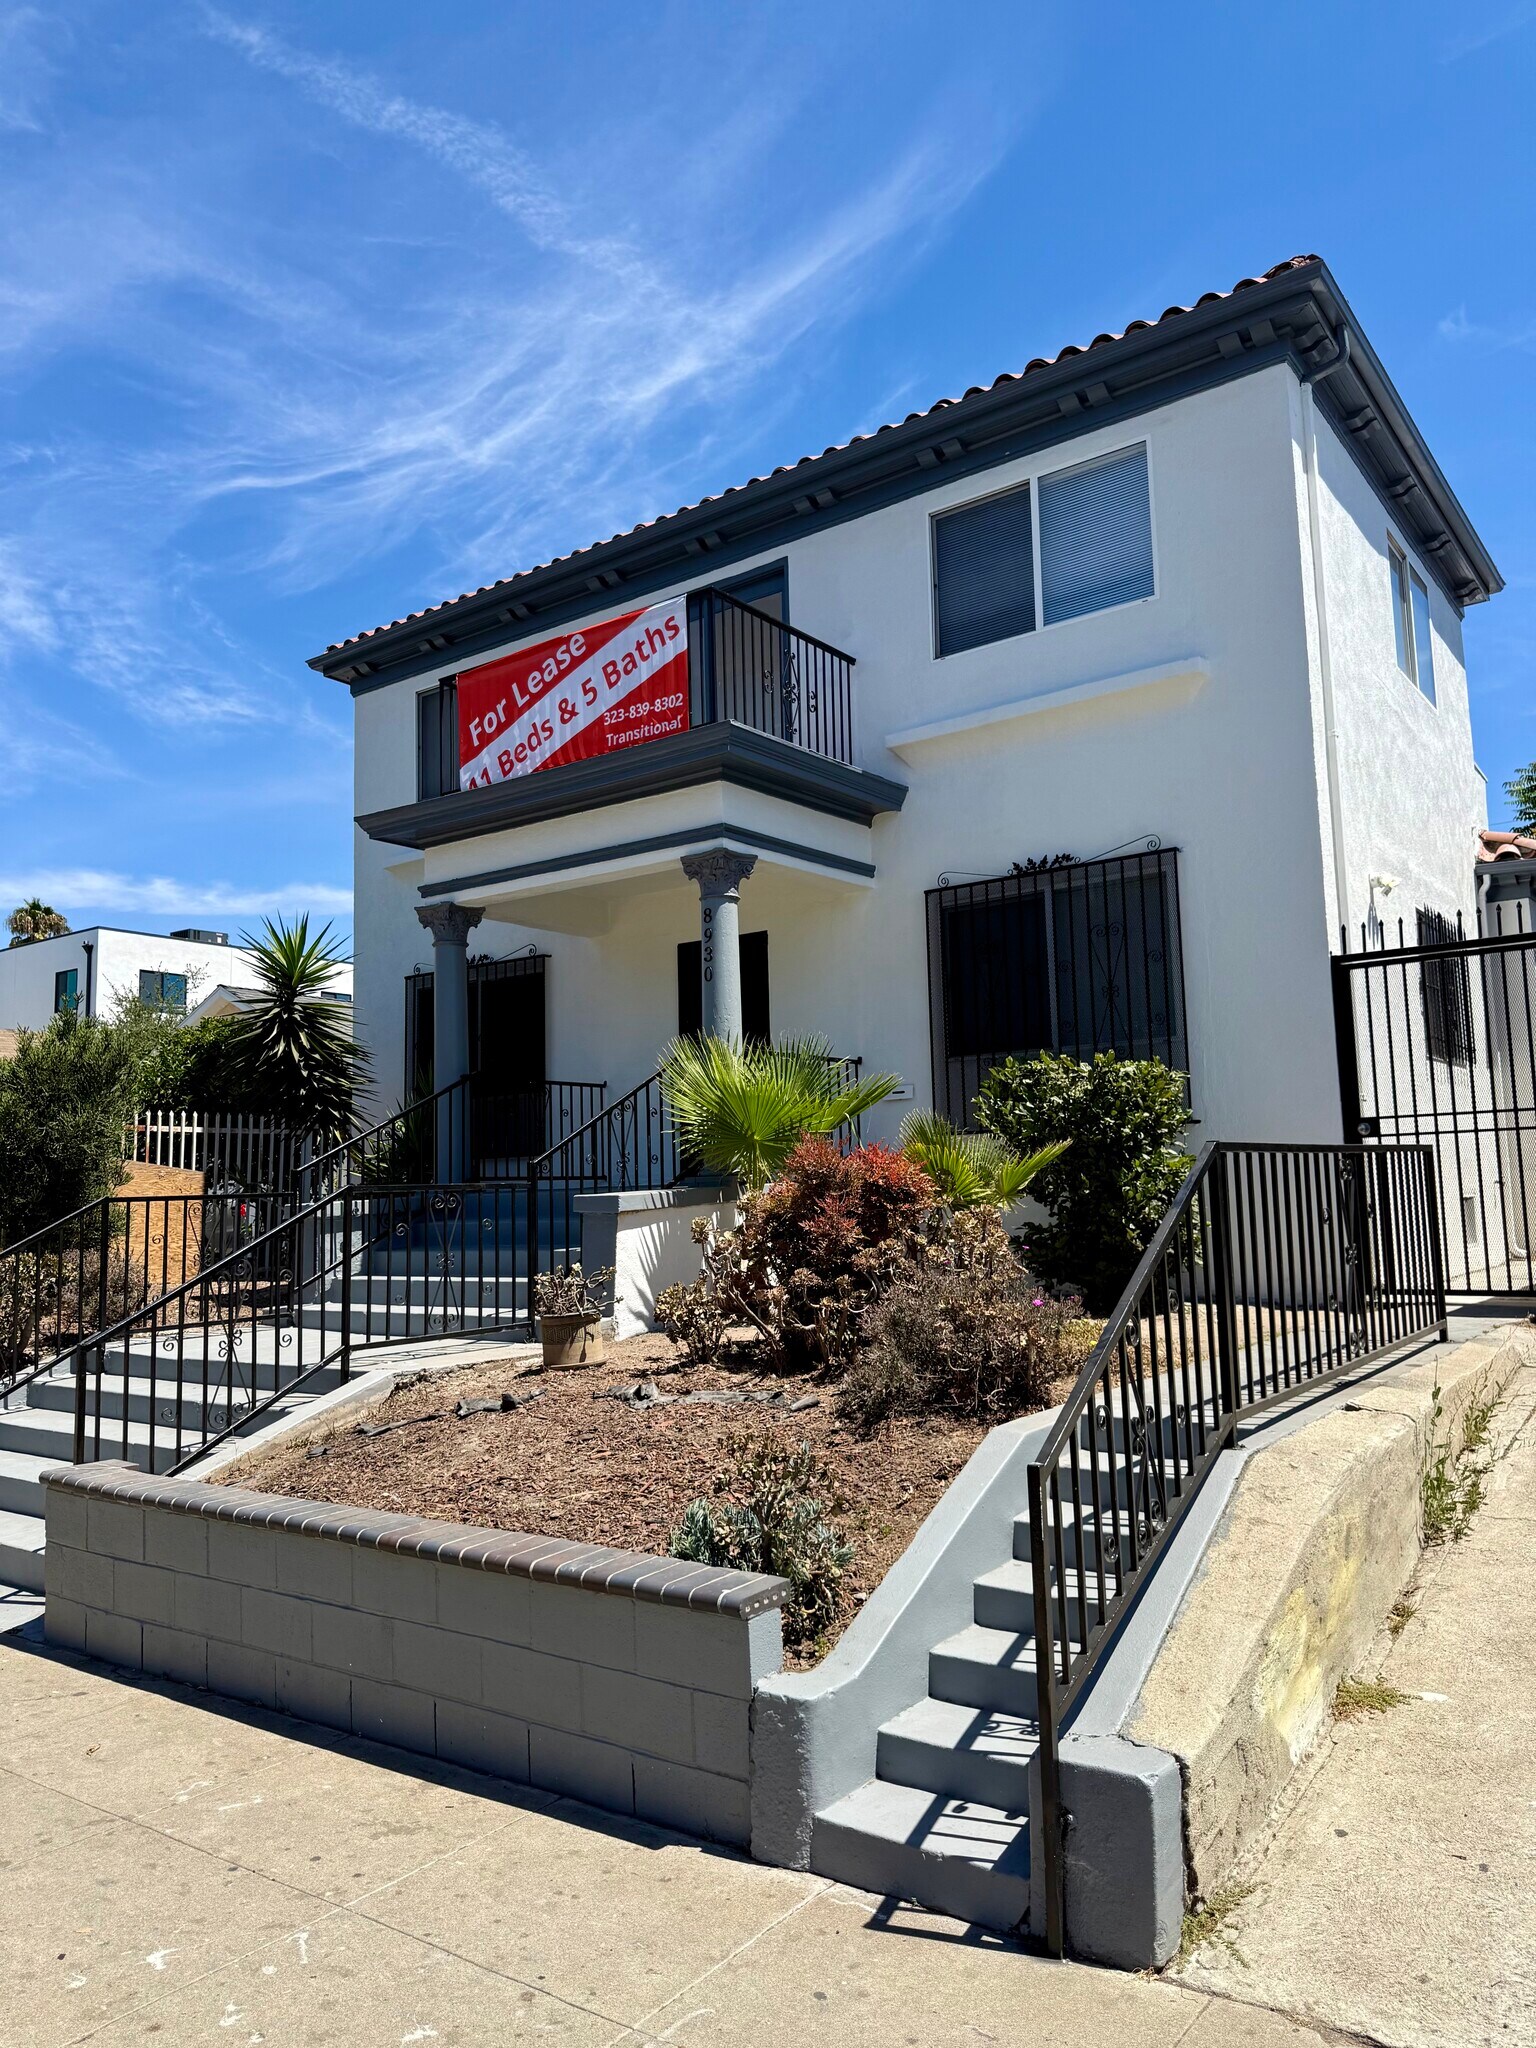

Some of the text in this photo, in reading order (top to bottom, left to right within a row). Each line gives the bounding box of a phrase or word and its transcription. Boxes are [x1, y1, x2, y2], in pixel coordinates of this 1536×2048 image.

[469, 634, 586, 746] For Lease
[497, 720, 554, 777] Beds
[558, 698, 579, 725] &
[581, 678, 598, 706] 5
[602, 616, 680, 690] Baths
[604, 693, 683, 725] 323-839-8302
[606, 714, 683, 747] Transitional
[703, 907, 713, 982] 8930
